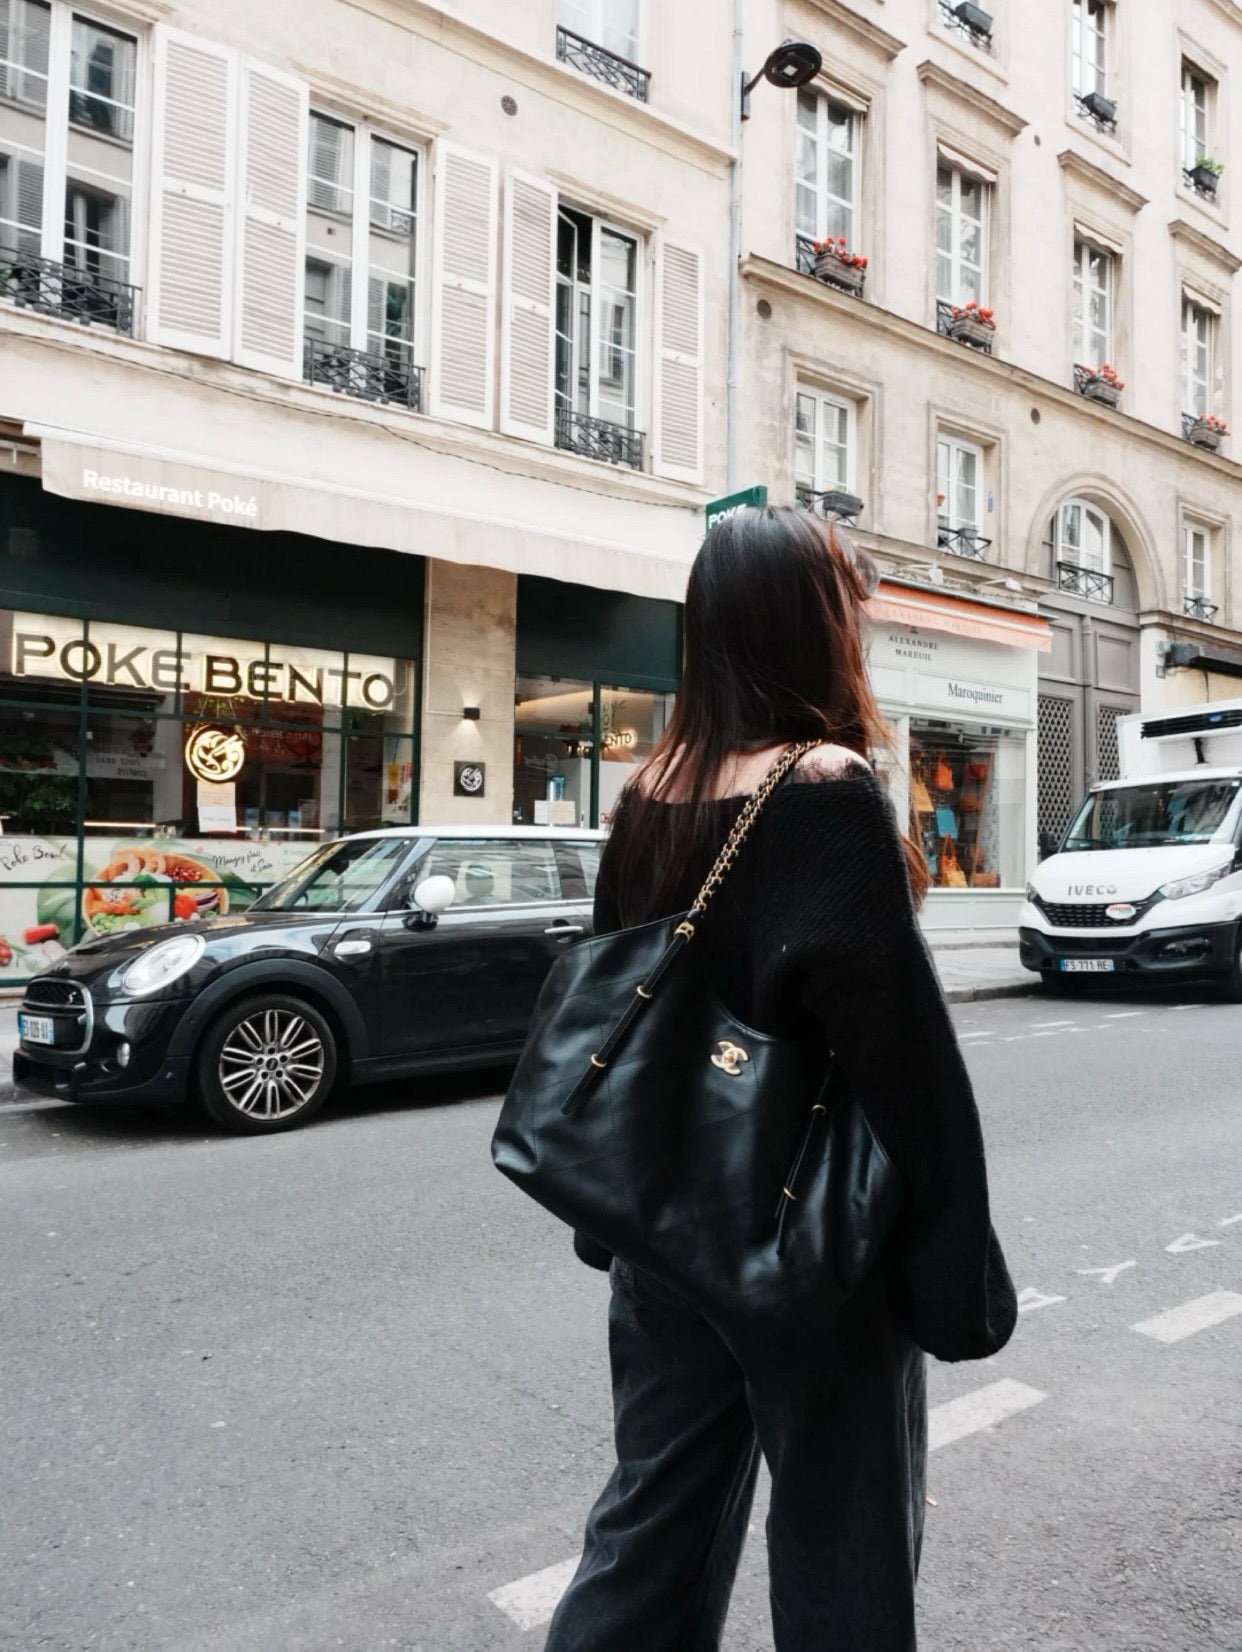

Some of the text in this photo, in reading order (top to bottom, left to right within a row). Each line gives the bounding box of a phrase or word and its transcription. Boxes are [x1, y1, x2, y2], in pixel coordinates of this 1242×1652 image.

[83, 469, 258, 517] Restaurant Poké
[888, 635, 938, 650] ALEXANDRE
[15, 632, 394, 709] POKE BENTO
[947, 682, 1004, 704] Maroquinier
[1067, 884, 1118, 897] IVECO
